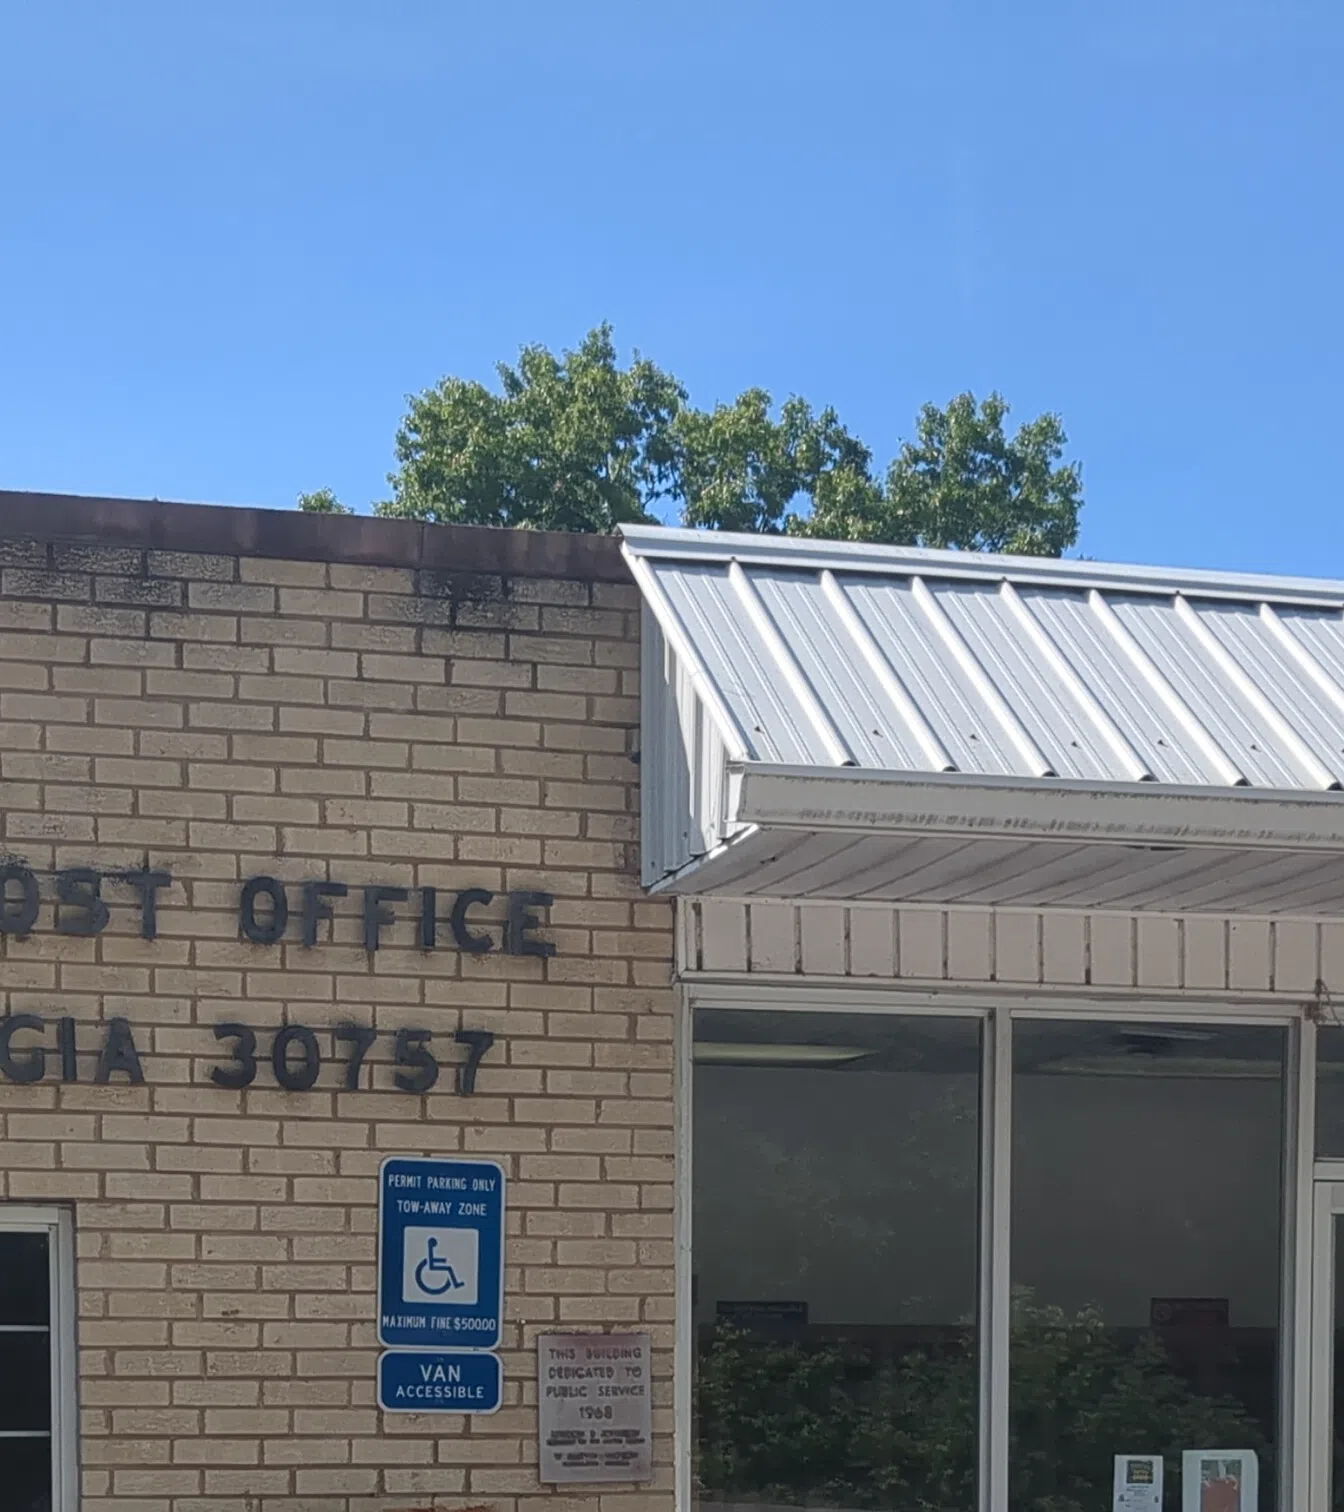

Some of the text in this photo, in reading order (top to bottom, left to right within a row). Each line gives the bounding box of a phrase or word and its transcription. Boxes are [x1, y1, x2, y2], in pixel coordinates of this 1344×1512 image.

[238, 874, 558, 957] OFFICE
[211, 1022, 495, 1096] 30757
[388, 1174, 496, 1192] PERMIT PARKING ONLY
[396, 1199, 488, 1216] TOW-AWAY ZONE
[382, 1315, 426, 1328] MAXIMUM
[431, 1316, 451, 1330] FINE
[548, 1347, 642, 1360] THIS BUILDING
[419, 1364, 461, 1382] VAN
[548, 1366, 642, 1379] DEDICATED TO
[395, 1385, 485, 1399] ACCESSIBLE
[546, 1385, 645, 1398] PUBLIC SERVICE
[578, 1405, 613, 1420] 1968
